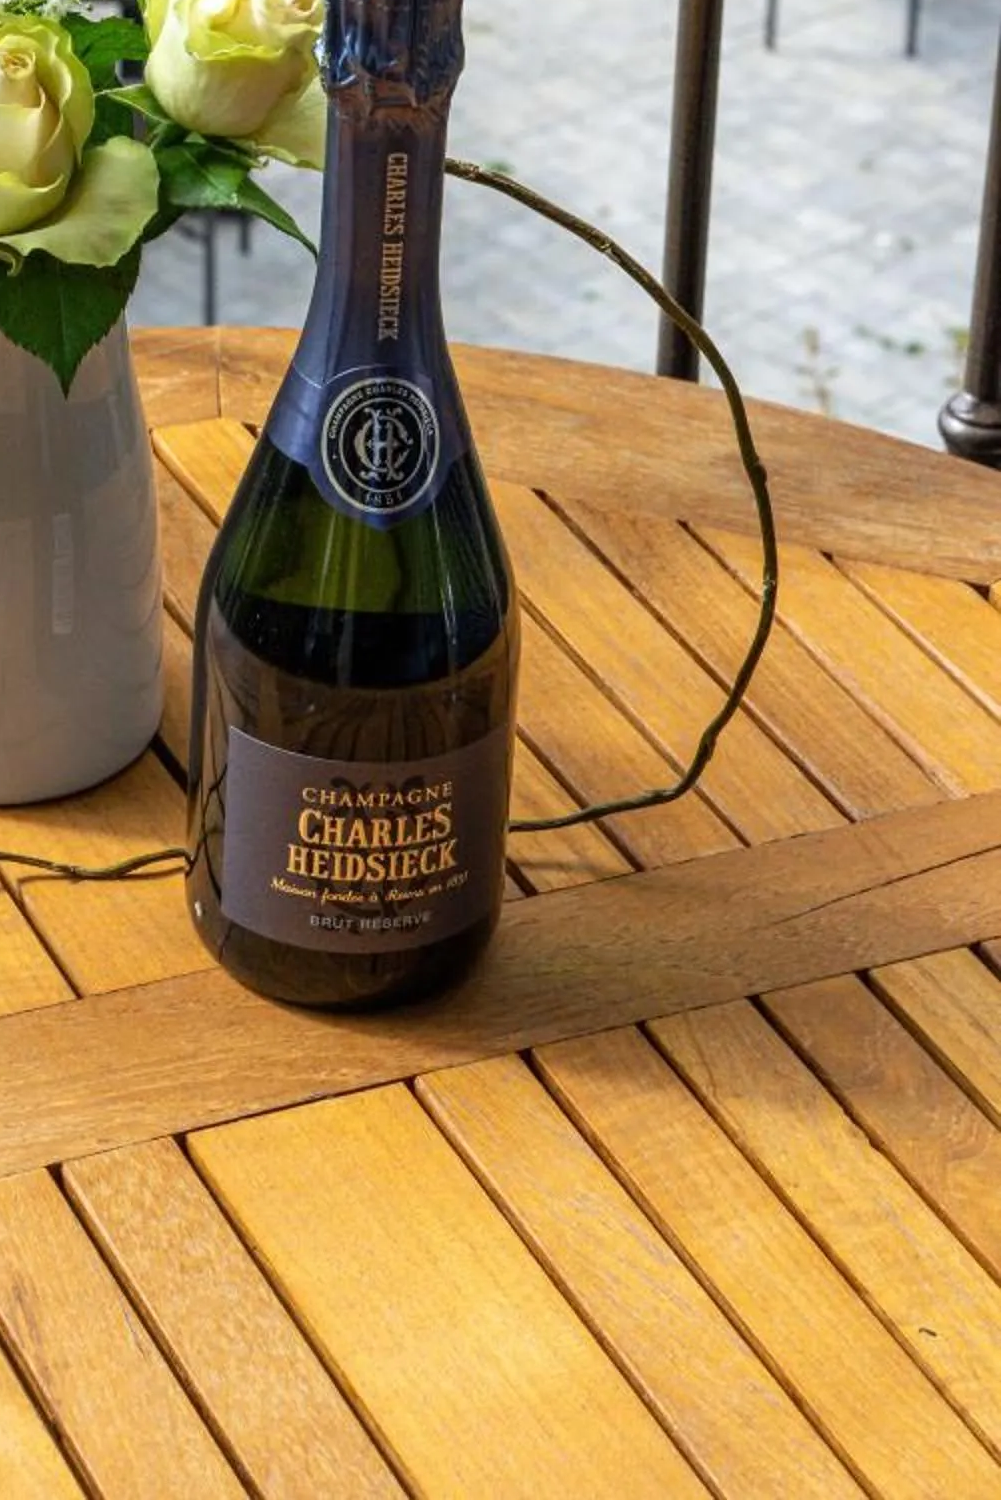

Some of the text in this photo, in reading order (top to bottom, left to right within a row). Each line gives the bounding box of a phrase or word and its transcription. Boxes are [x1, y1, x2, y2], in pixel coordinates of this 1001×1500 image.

[377, 152, 408, 341] CHARLES HEIDSIECK
[302, 781, 453, 808] CHAMPAGNE
[298, 803, 452, 848] CHARLES
[286, 838, 457, 883] HEIDSIECK
[269, 876, 316, 898] Maison
[309, 914, 353, 930] BRUT
